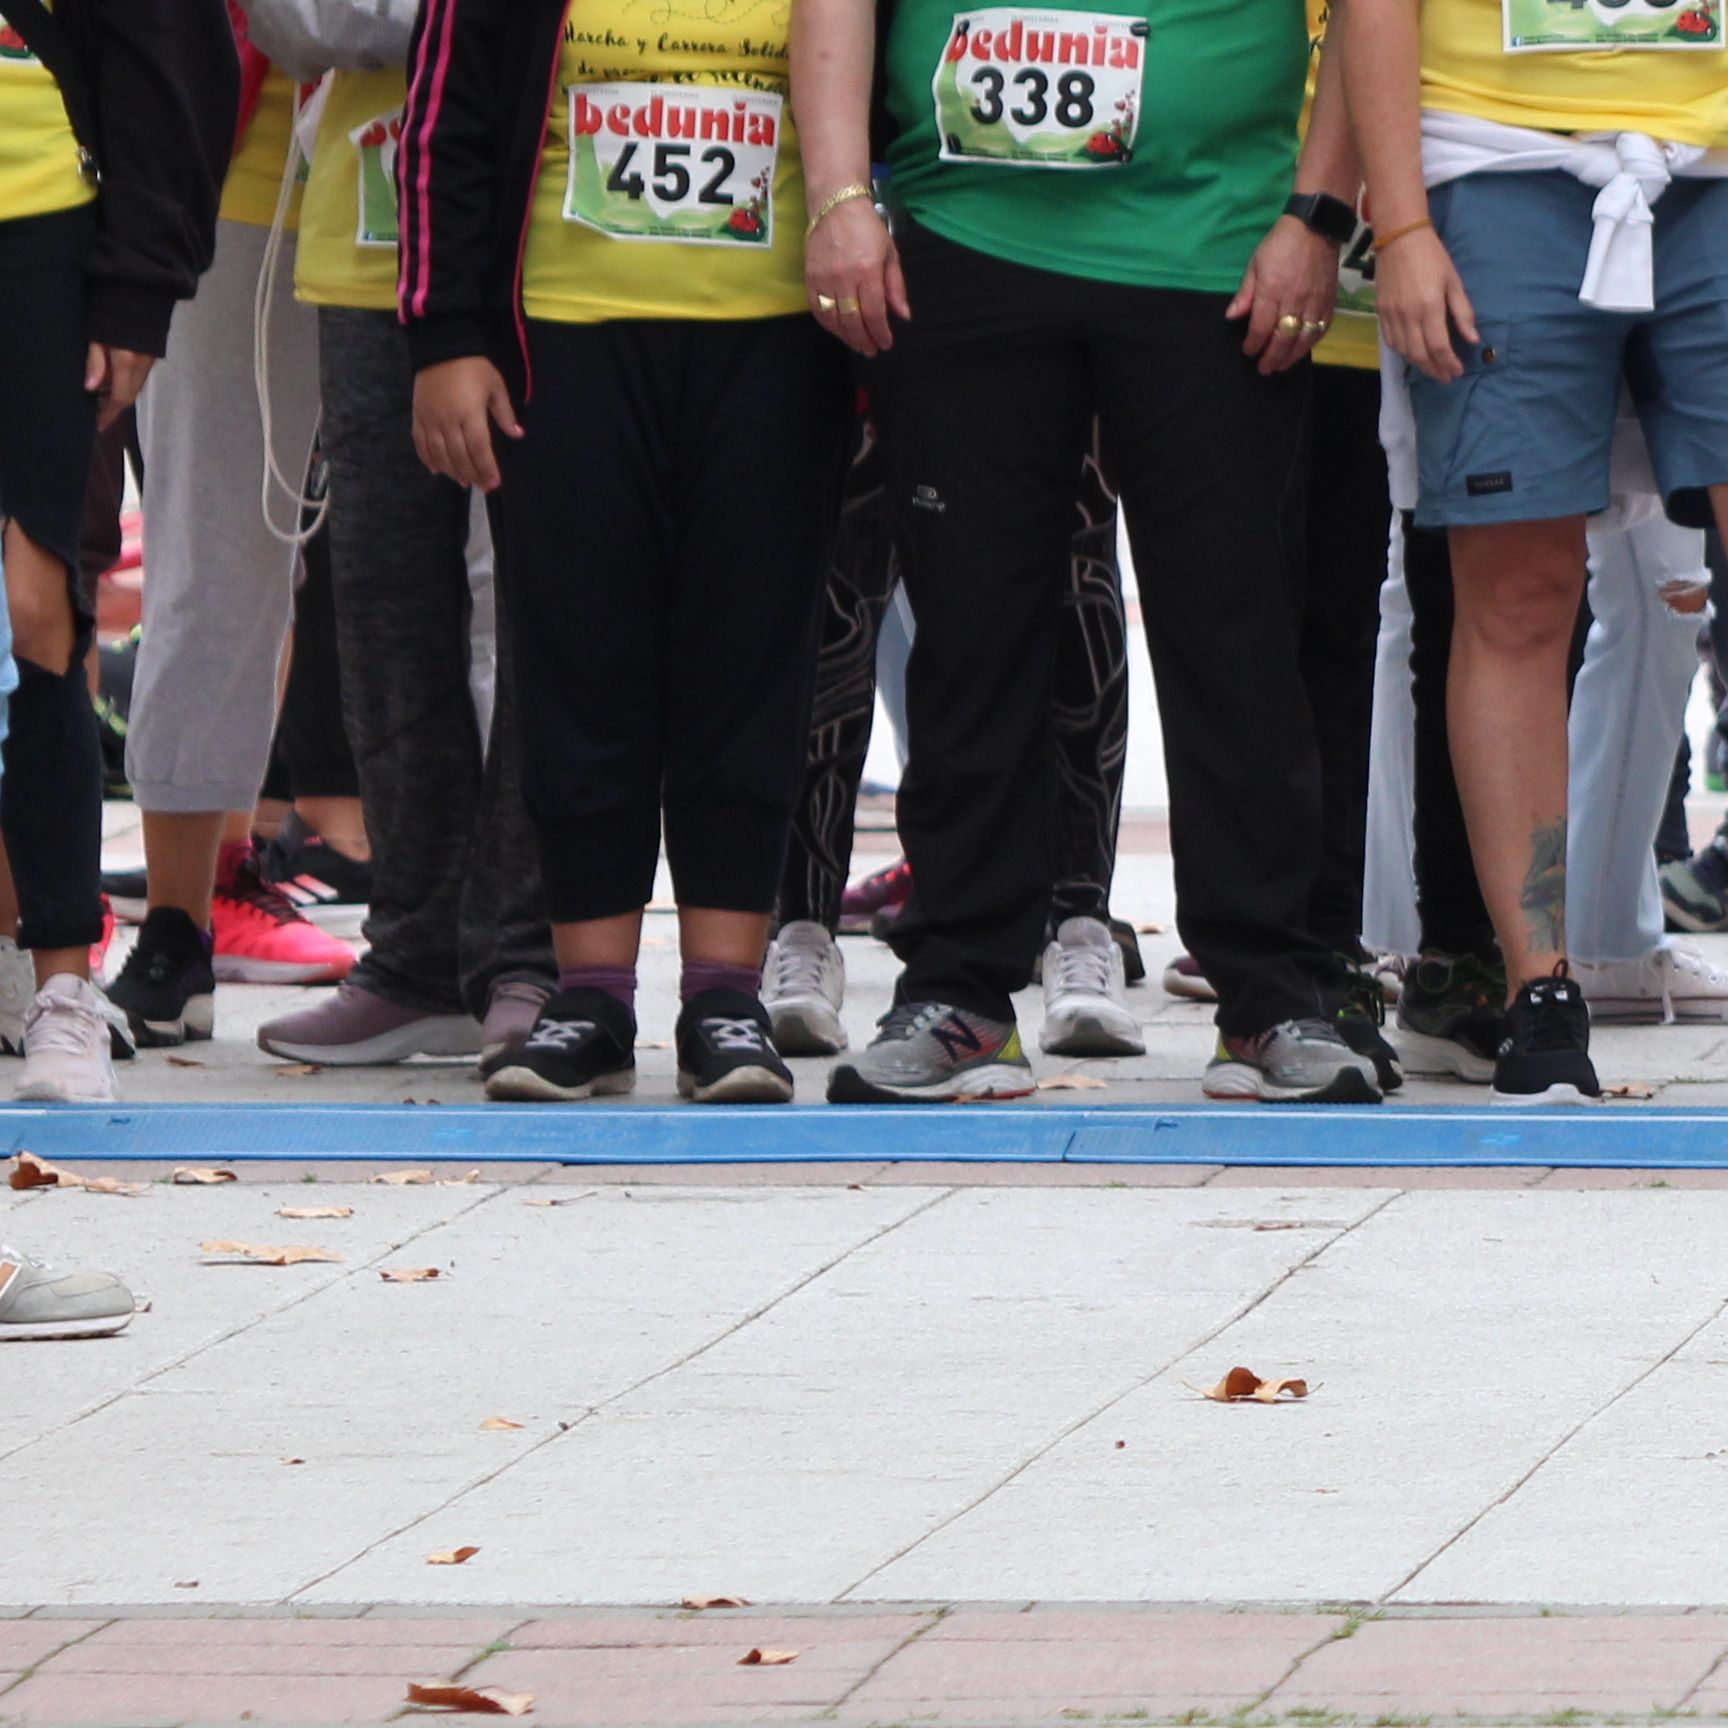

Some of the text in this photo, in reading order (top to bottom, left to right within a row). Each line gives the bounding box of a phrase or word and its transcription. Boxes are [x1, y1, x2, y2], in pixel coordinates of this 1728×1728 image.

[563, 18, 628, 48] Marcha
[636, 37, 647, 54] y
[656, 32, 727, 54] Carrera
[944, 19, 1140, 70] bedunia
[574, 94, 776, 148] bedunia
[969, 65, 1096, 128] 338
[605, 141, 736, 206] 452
